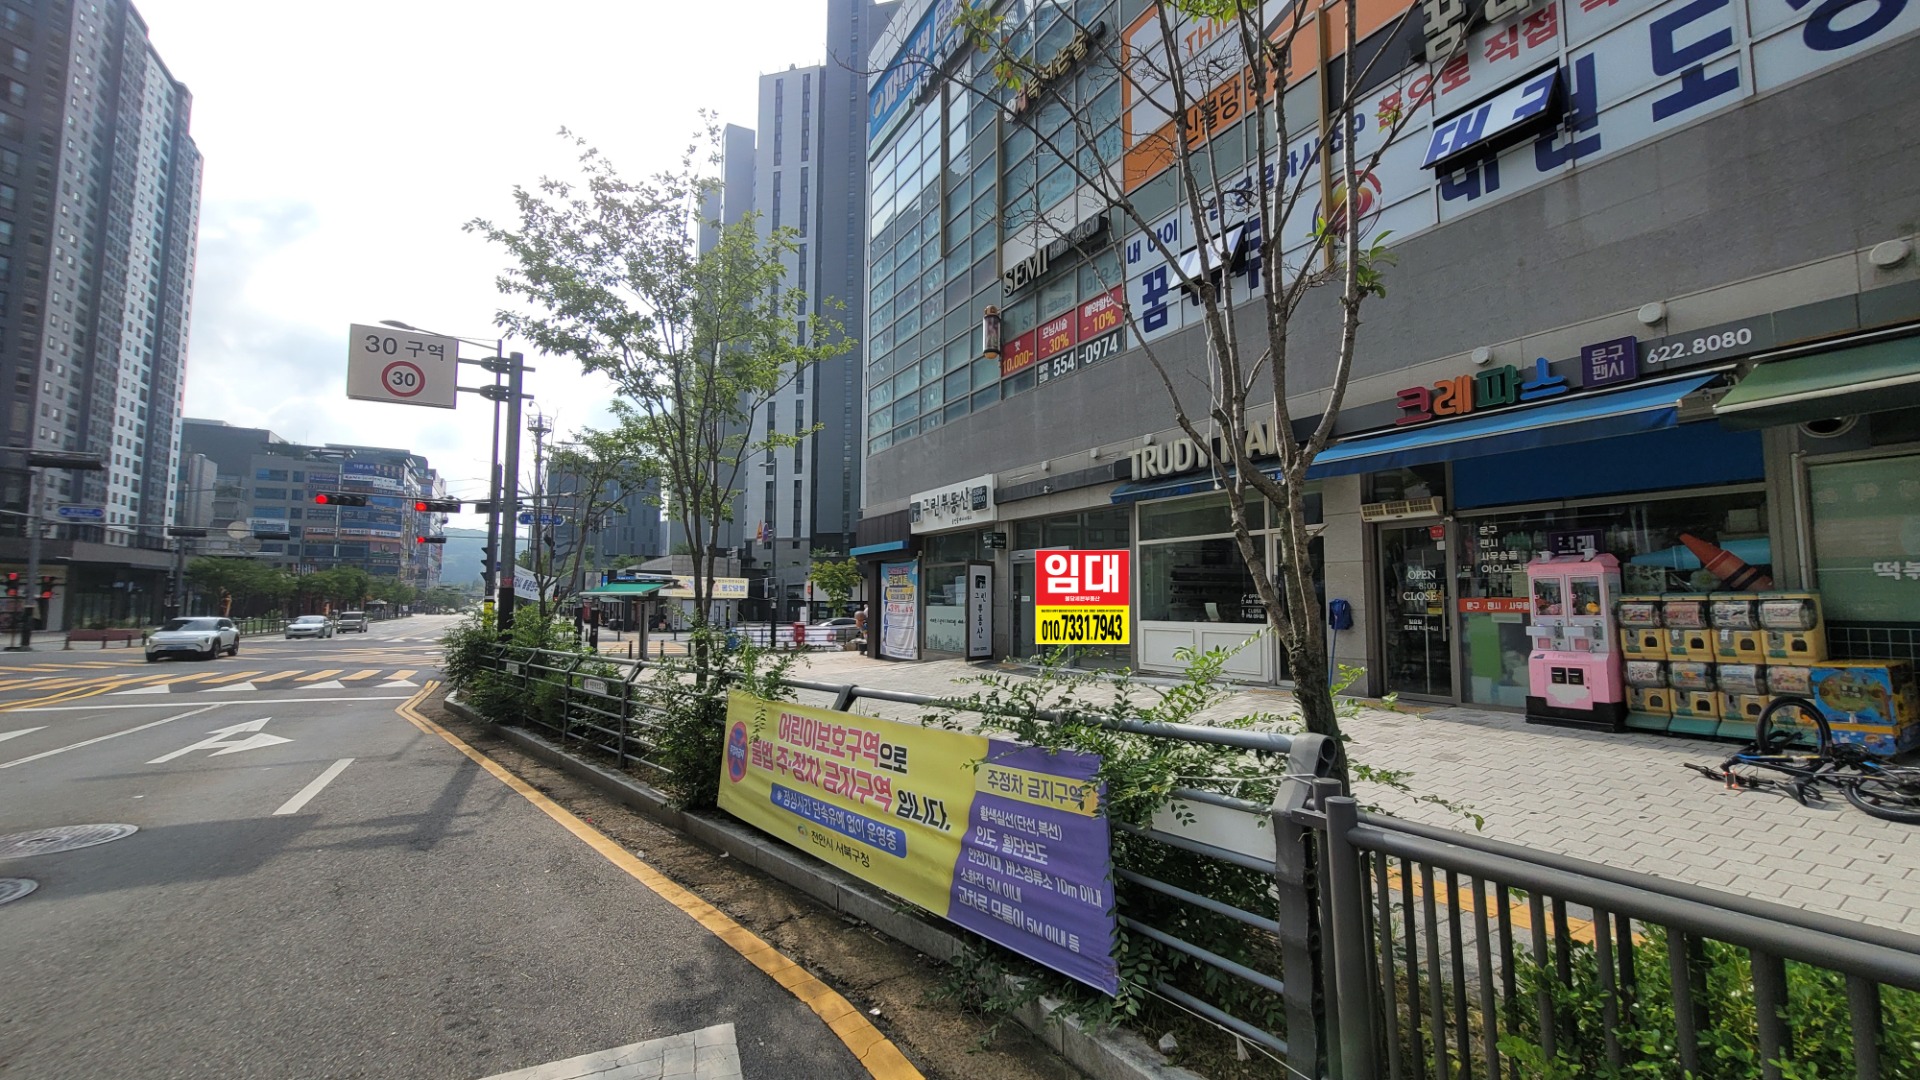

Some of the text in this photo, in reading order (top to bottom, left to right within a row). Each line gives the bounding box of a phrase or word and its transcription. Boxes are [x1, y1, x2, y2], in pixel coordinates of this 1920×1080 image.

[1127, 240, 1141, 265] 내
[1147, 219, 1178, 252] 아이
[1484, 1, 1557, 64] 직접
[1003, 245, 1048, 298] SEMI
[1093, 309, 1115, 332] 10%
[365, 335, 444, 361] 30 구역
[1049, 332, 1069, 353] 30%
[1053, 333, 1118, 376] 554-0974
[1591, 345, 1624, 365] 문구
[1647, 328, 1752, 363] 622.8080
[392, 371, 416, 387] 30
[1592, 360, 1625, 380] 팬시
[1395, 357, 1569, 425] 크레파스
[1128, 433, 1210, 481] TRUDY
[922, 487, 970, 517] 그린부동산
[1479, 525, 1498, 535] 문구
[1479, 538, 1498, 548] 팬시
[1481, 550, 1518, 560] 사무용품
[1407, 570, 1436, 579] OPEN
[1418, 582, 1437, 590] 8:00
[1402, 591, 1437, 601] CLOSE
[974, 592, 986, 639] 그린부동산
[779, 712, 908, 774] 어린이보호구역으로
[751, 740, 774, 771] 불법
[823, 760, 893, 813] 금지구역
[896, 789, 951, 831] 입니다.
[987, 769, 1024, 795] 주정차
[783, 789, 897, 850] 점심시간 단속유예 없이 운영중
[811, 830, 871, 868] 천안시 서북구청
[974, 825, 1049, 866] 인도, 횡단보도
[960, 867, 1022, 904] 소화전 5M 이내
[1005, 860, 1053, 891] 버스정류소
[1055, 877, 1078, 900] 10m
[1080, 884, 1102, 909] 이내
[957, 885, 1080, 954] 교차로 모퉁이 5M 이내 등
